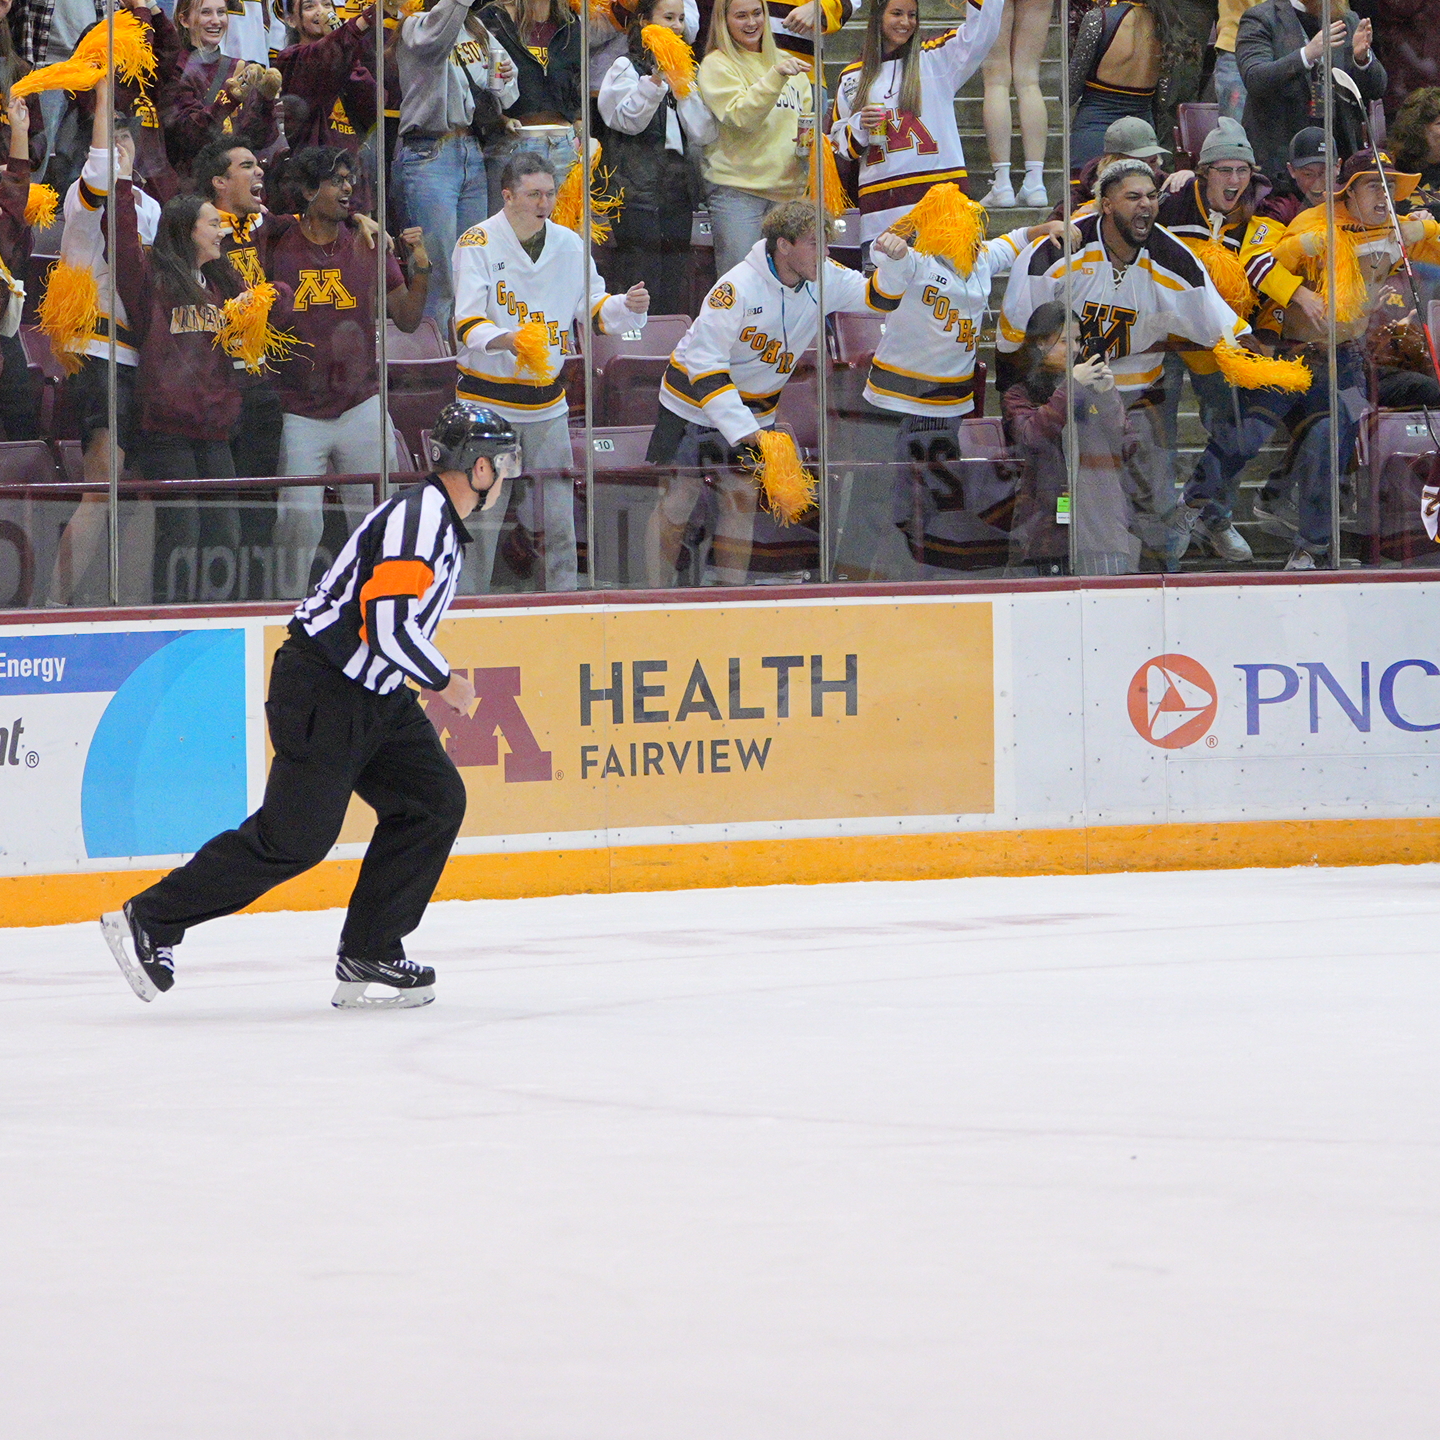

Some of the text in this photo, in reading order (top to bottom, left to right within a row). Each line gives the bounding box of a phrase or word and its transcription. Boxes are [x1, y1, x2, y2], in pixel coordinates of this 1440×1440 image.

[293, 269, 356, 312] M
[579, 653, 858, 727] HEALTH
[580, 737, 773, 781] FAIRVIEW
